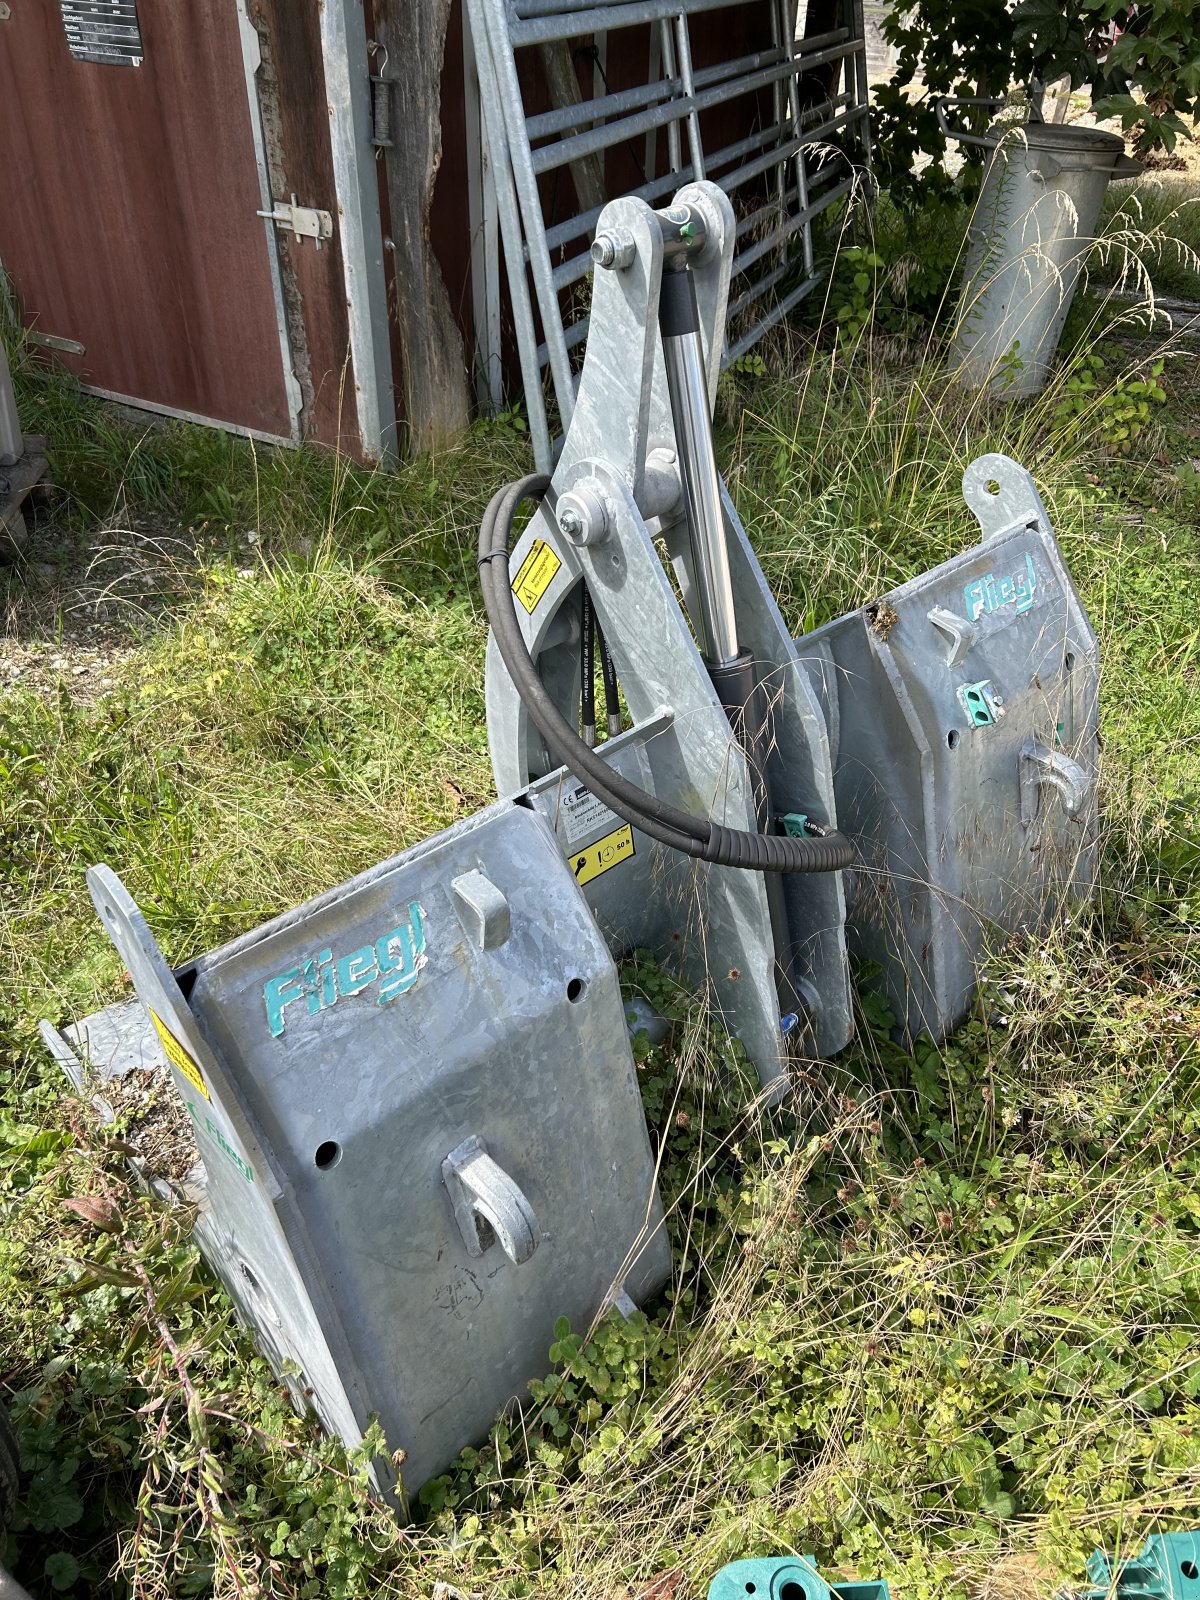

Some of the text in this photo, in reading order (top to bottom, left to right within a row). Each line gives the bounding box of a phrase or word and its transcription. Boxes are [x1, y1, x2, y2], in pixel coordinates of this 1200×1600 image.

[964, 552, 1036, 621] Fliegl
[617, 842, 625, 850] 50
[264, 901, 426, 1037] Fliegl
[206, 1117, 253, 1183] Fliegl
